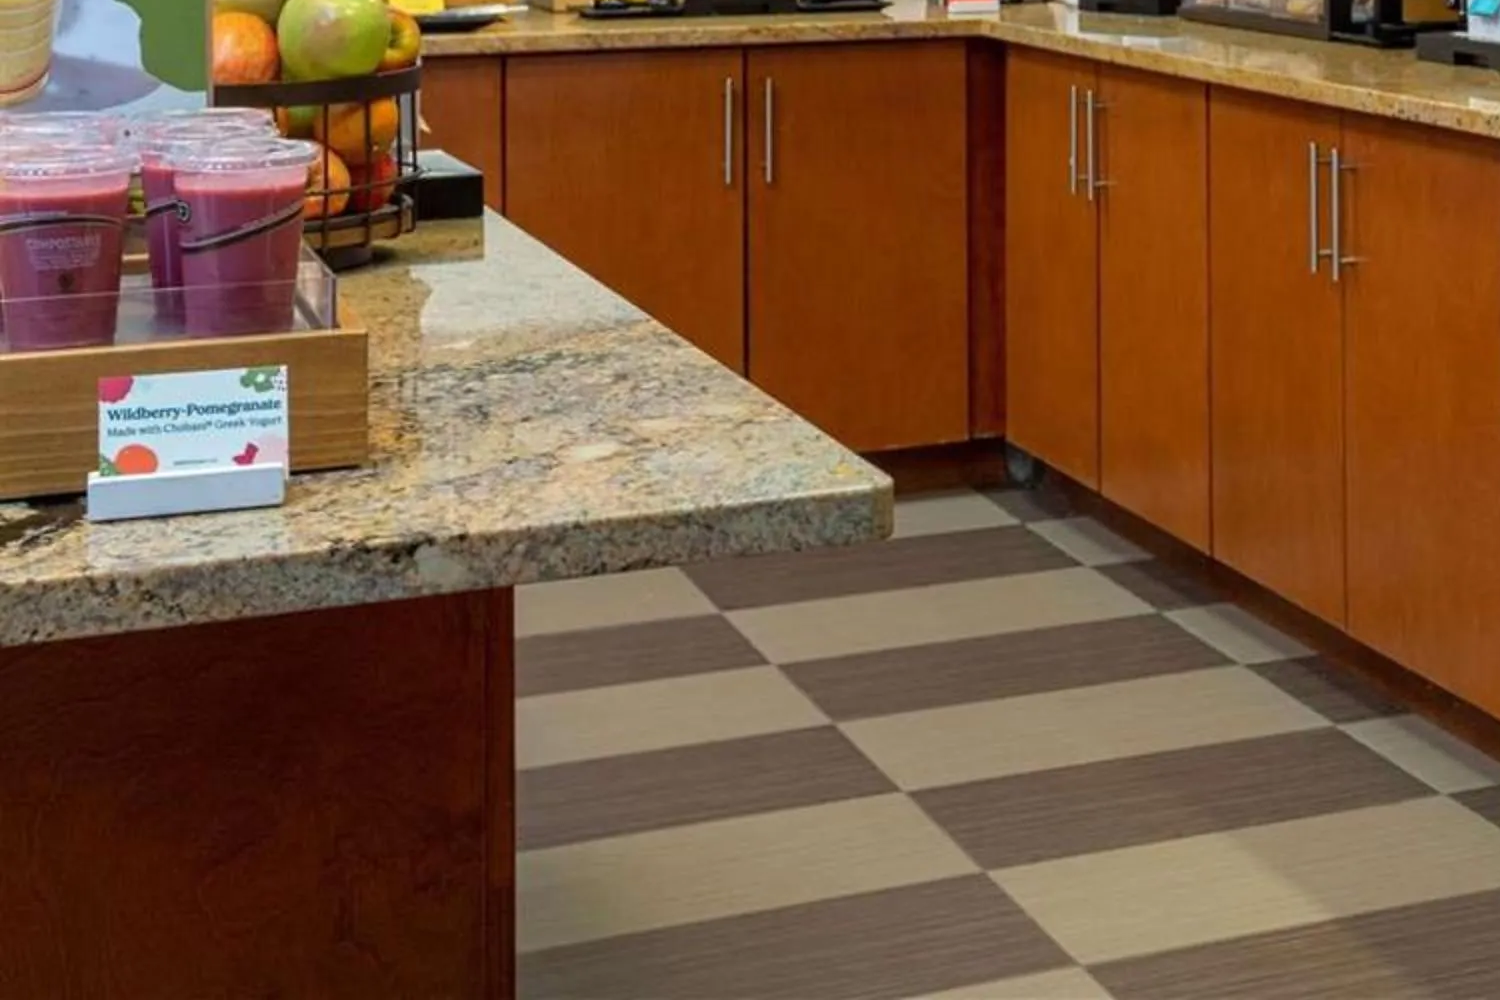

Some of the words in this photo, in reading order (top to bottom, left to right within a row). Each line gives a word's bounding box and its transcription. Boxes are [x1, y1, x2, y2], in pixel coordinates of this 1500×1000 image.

[107, 398, 283, 422] Wildberry-Pomegranate
[107, 427, 136, 437] Made
[138, 423, 162, 435] with
[215, 418, 246, 430] Greek
